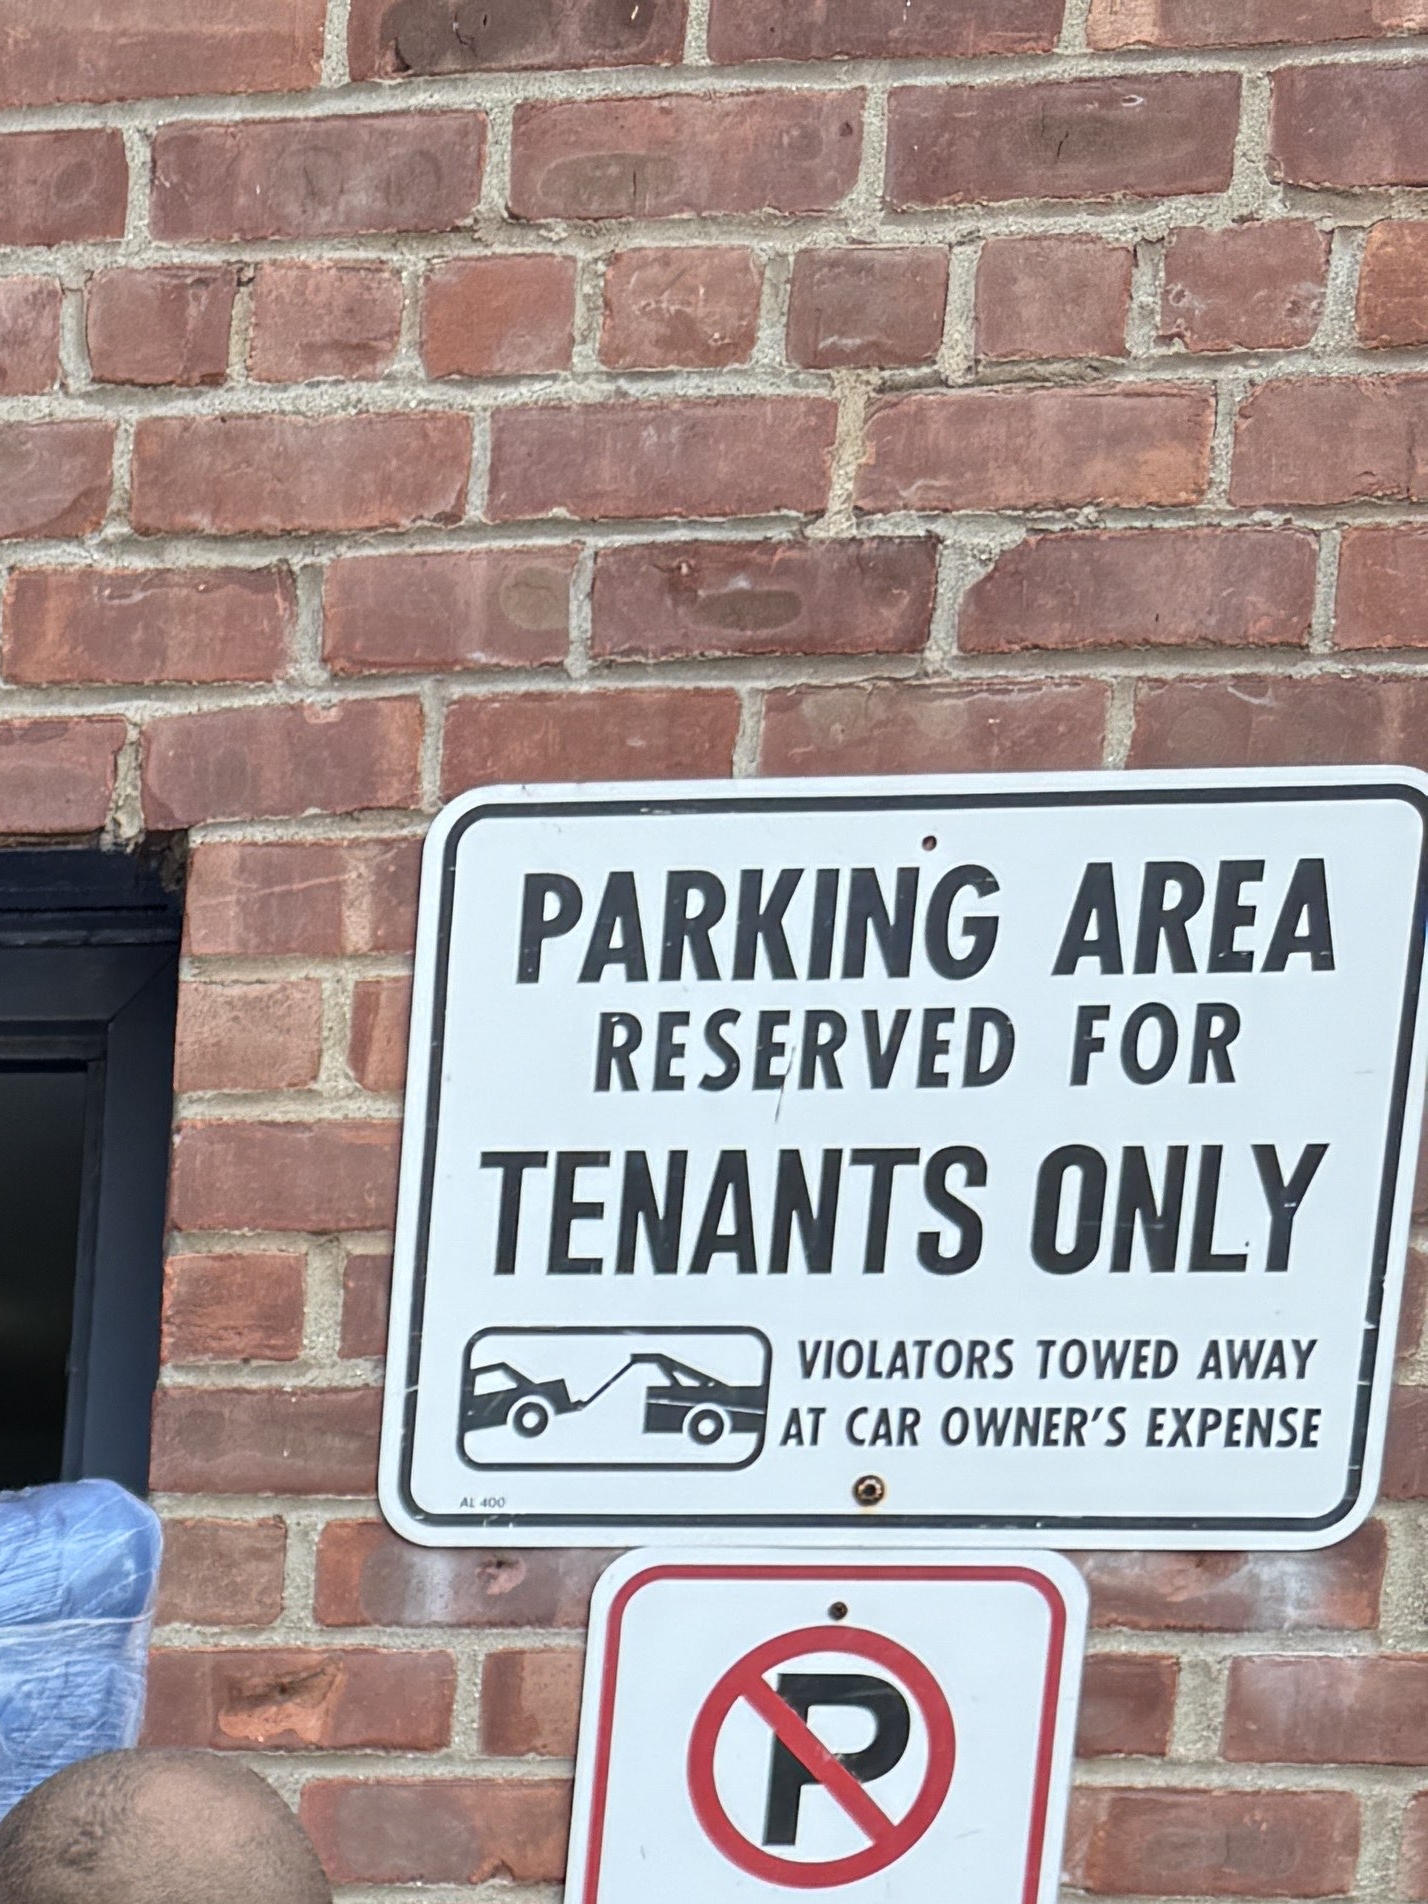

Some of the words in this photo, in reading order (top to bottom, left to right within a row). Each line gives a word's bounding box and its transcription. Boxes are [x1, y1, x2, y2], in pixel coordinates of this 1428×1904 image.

[516, 864, 1001, 983] PARKING
[1052, 858, 1335, 976] AREA
[594, 1006, 1015, 1092] RESERVED
[1070, 1003, 1241, 1085] FOR
[480, 1146, 987, 1275] TENANTS
[1031, 1143, 1330, 1275] ONLY
[798, 1339, 1013, 1379] VIOLATORS
[1036, 1339, 1178, 1378] TOWED
[1198, 1339, 1317, 1378] AWAY
[780, 1408, 822, 1447] AT
[846, 1407, 920, 1447] CAR
[942, 1407, 1125, 1447] OWNER'S
[1145, 1408, 1322, 1447] EXPENSE
